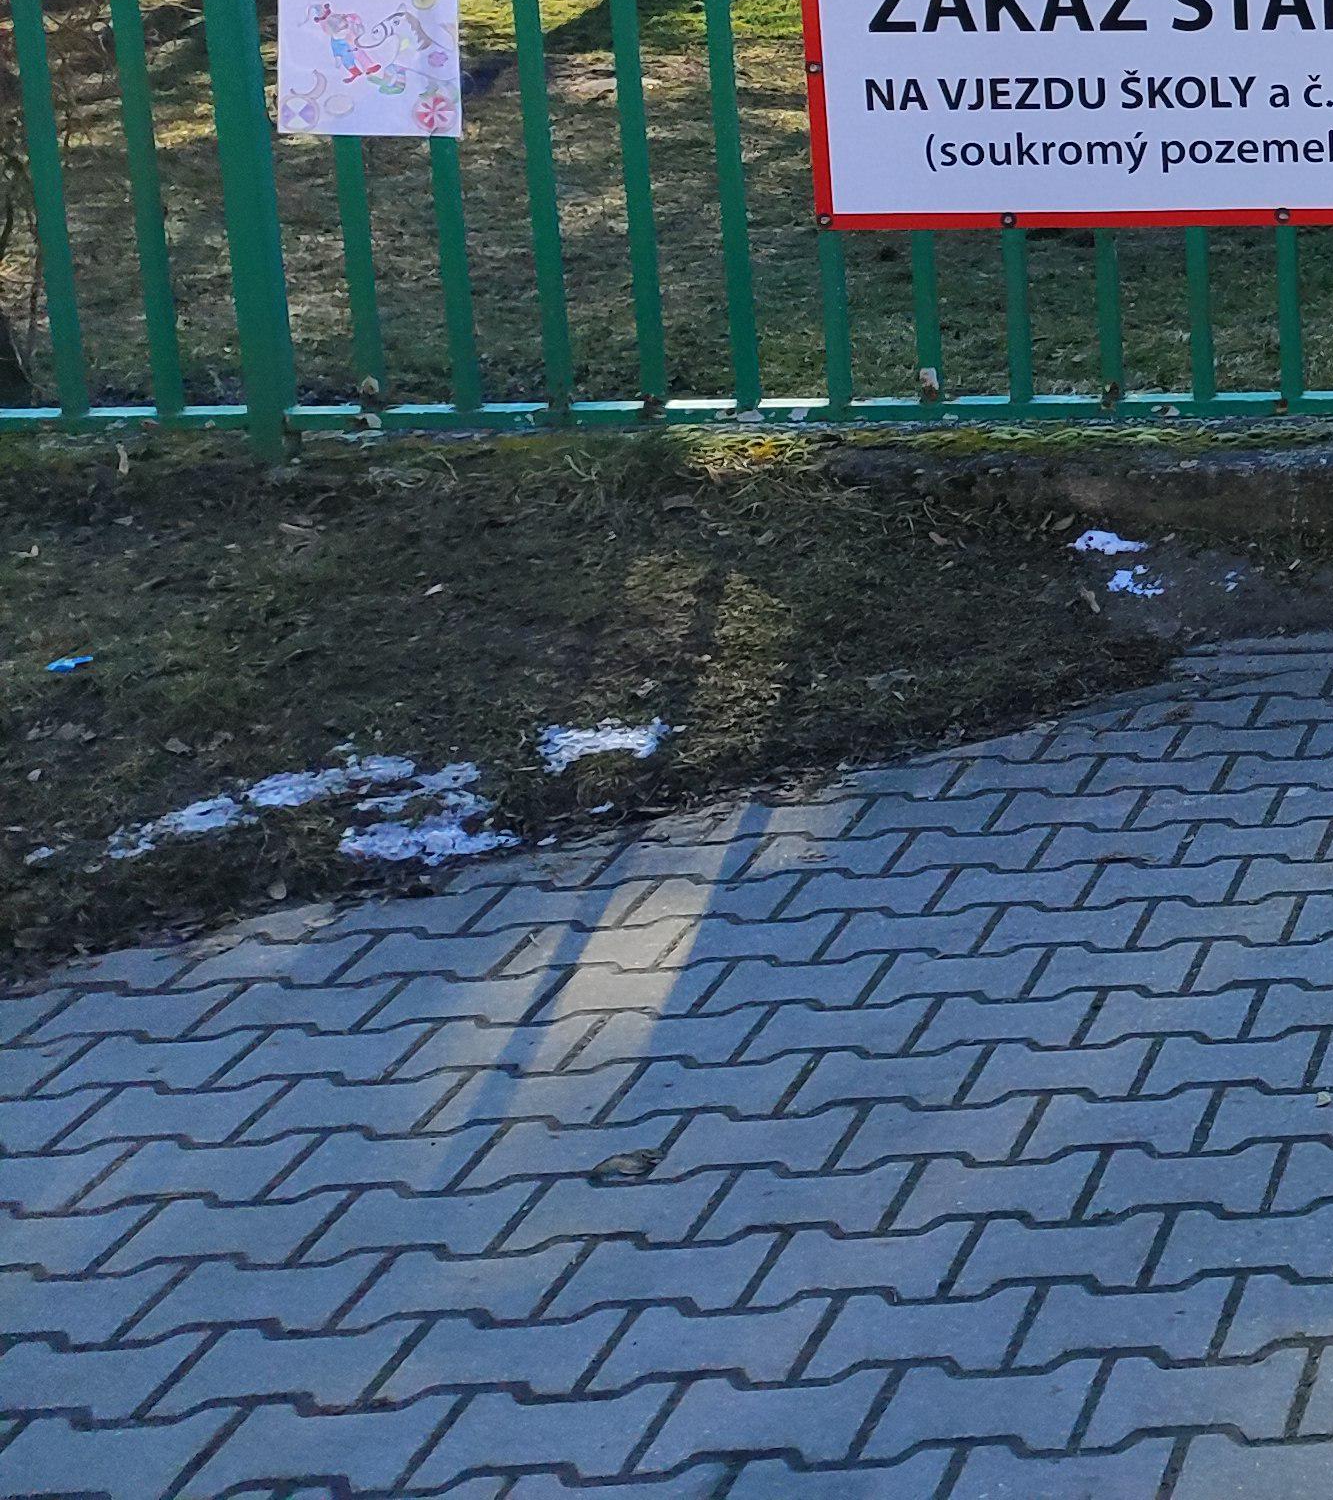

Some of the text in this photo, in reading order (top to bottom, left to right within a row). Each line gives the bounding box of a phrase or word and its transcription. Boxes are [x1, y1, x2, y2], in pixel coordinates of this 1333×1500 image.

[864, 78, 929, 111] NA
[936, 77, 1106, 111] VJEZDU
[1120, 69, 1257, 110] ŠKOLY
[1269, 84, 1290, 109] a
[925, 131, 1148, 175] (soukromý
